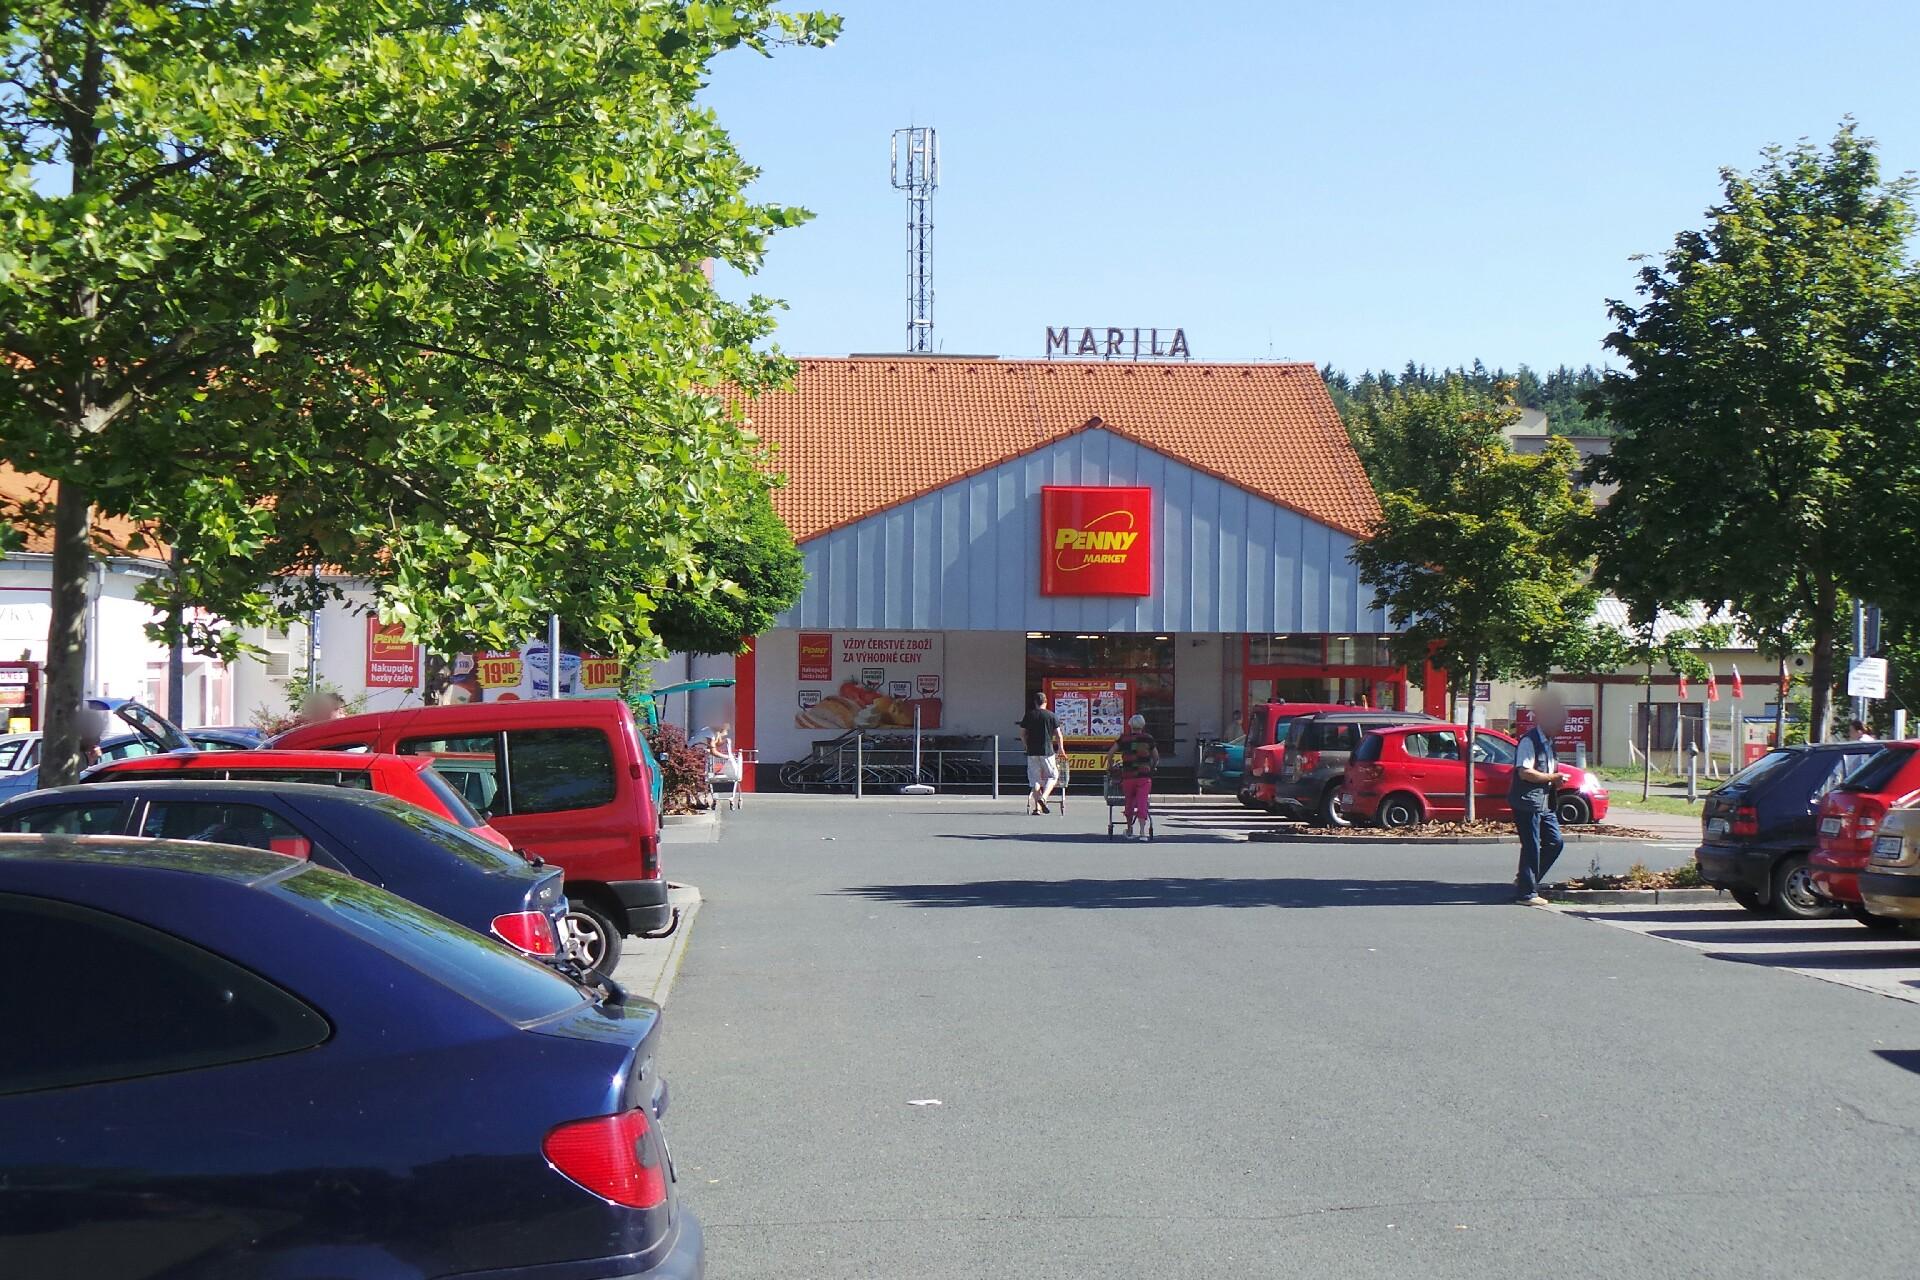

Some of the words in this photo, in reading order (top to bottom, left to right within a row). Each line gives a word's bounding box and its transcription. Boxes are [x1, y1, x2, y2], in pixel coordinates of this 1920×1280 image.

[1046, 326, 1190, 356] MARILA
[1054, 528, 1138, 551] PENNY
[1083, 554, 1127, 564] MARKET
[843, 638, 865, 650] VŽDY
[867, 638, 905, 650] ČERSTVÉ
[907, 638, 933, 650] ZBOŽÍ
[843, 653, 854, 663] ZA
[856, 651, 899, 663] VÝHODNÉ
[899, 653, 922, 663] CENY
[371, 664, 414, 674] Nakupujte
